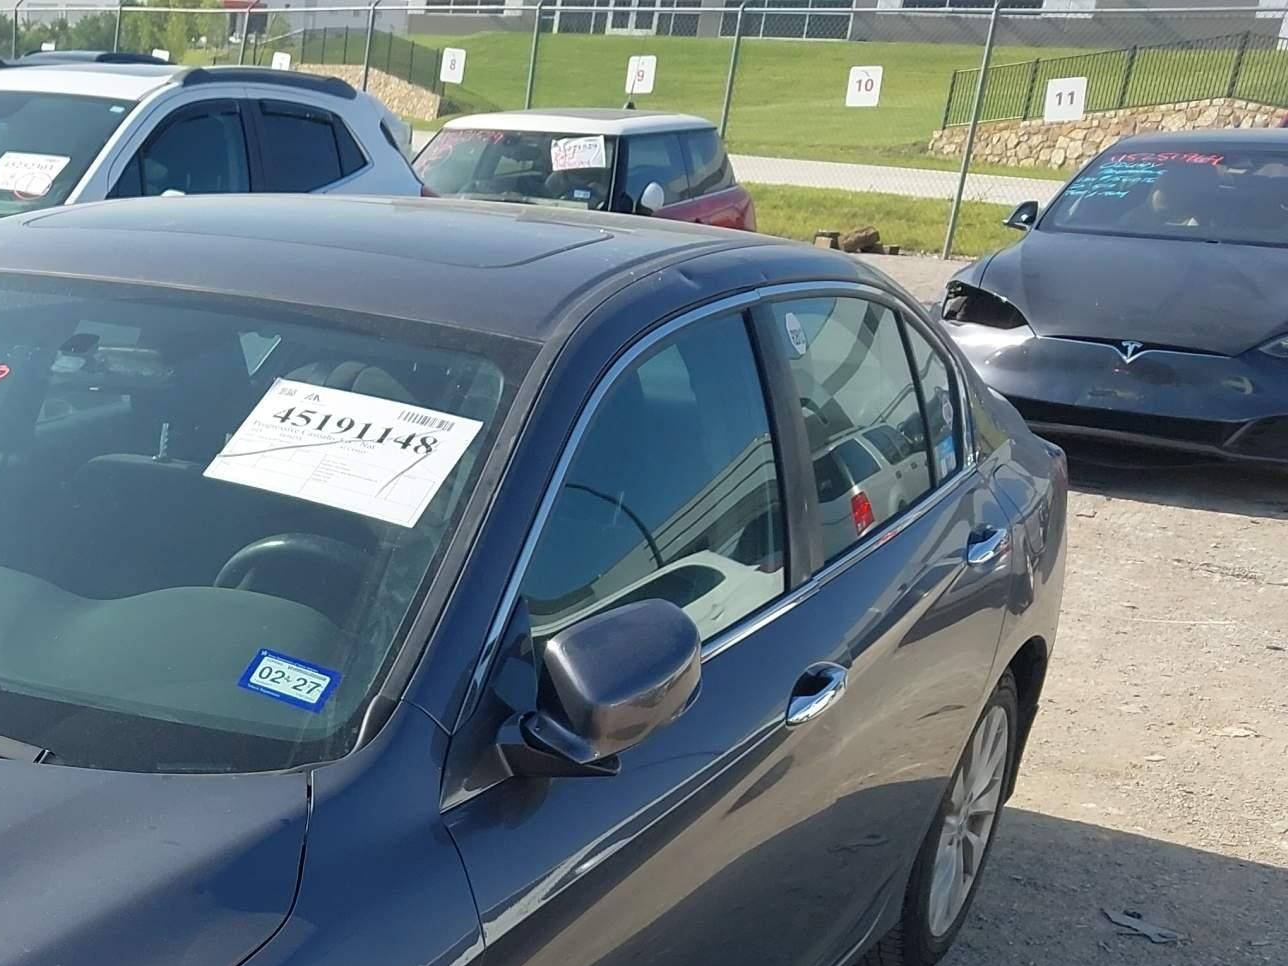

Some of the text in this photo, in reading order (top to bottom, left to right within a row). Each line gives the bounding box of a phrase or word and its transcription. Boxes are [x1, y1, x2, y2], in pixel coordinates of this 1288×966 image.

[636, 69, 645, 82] 9
[854, 78, 874, 92] 10
[1055, 91, 1076, 106] 11
[272, 405, 439, 455] 45191148
